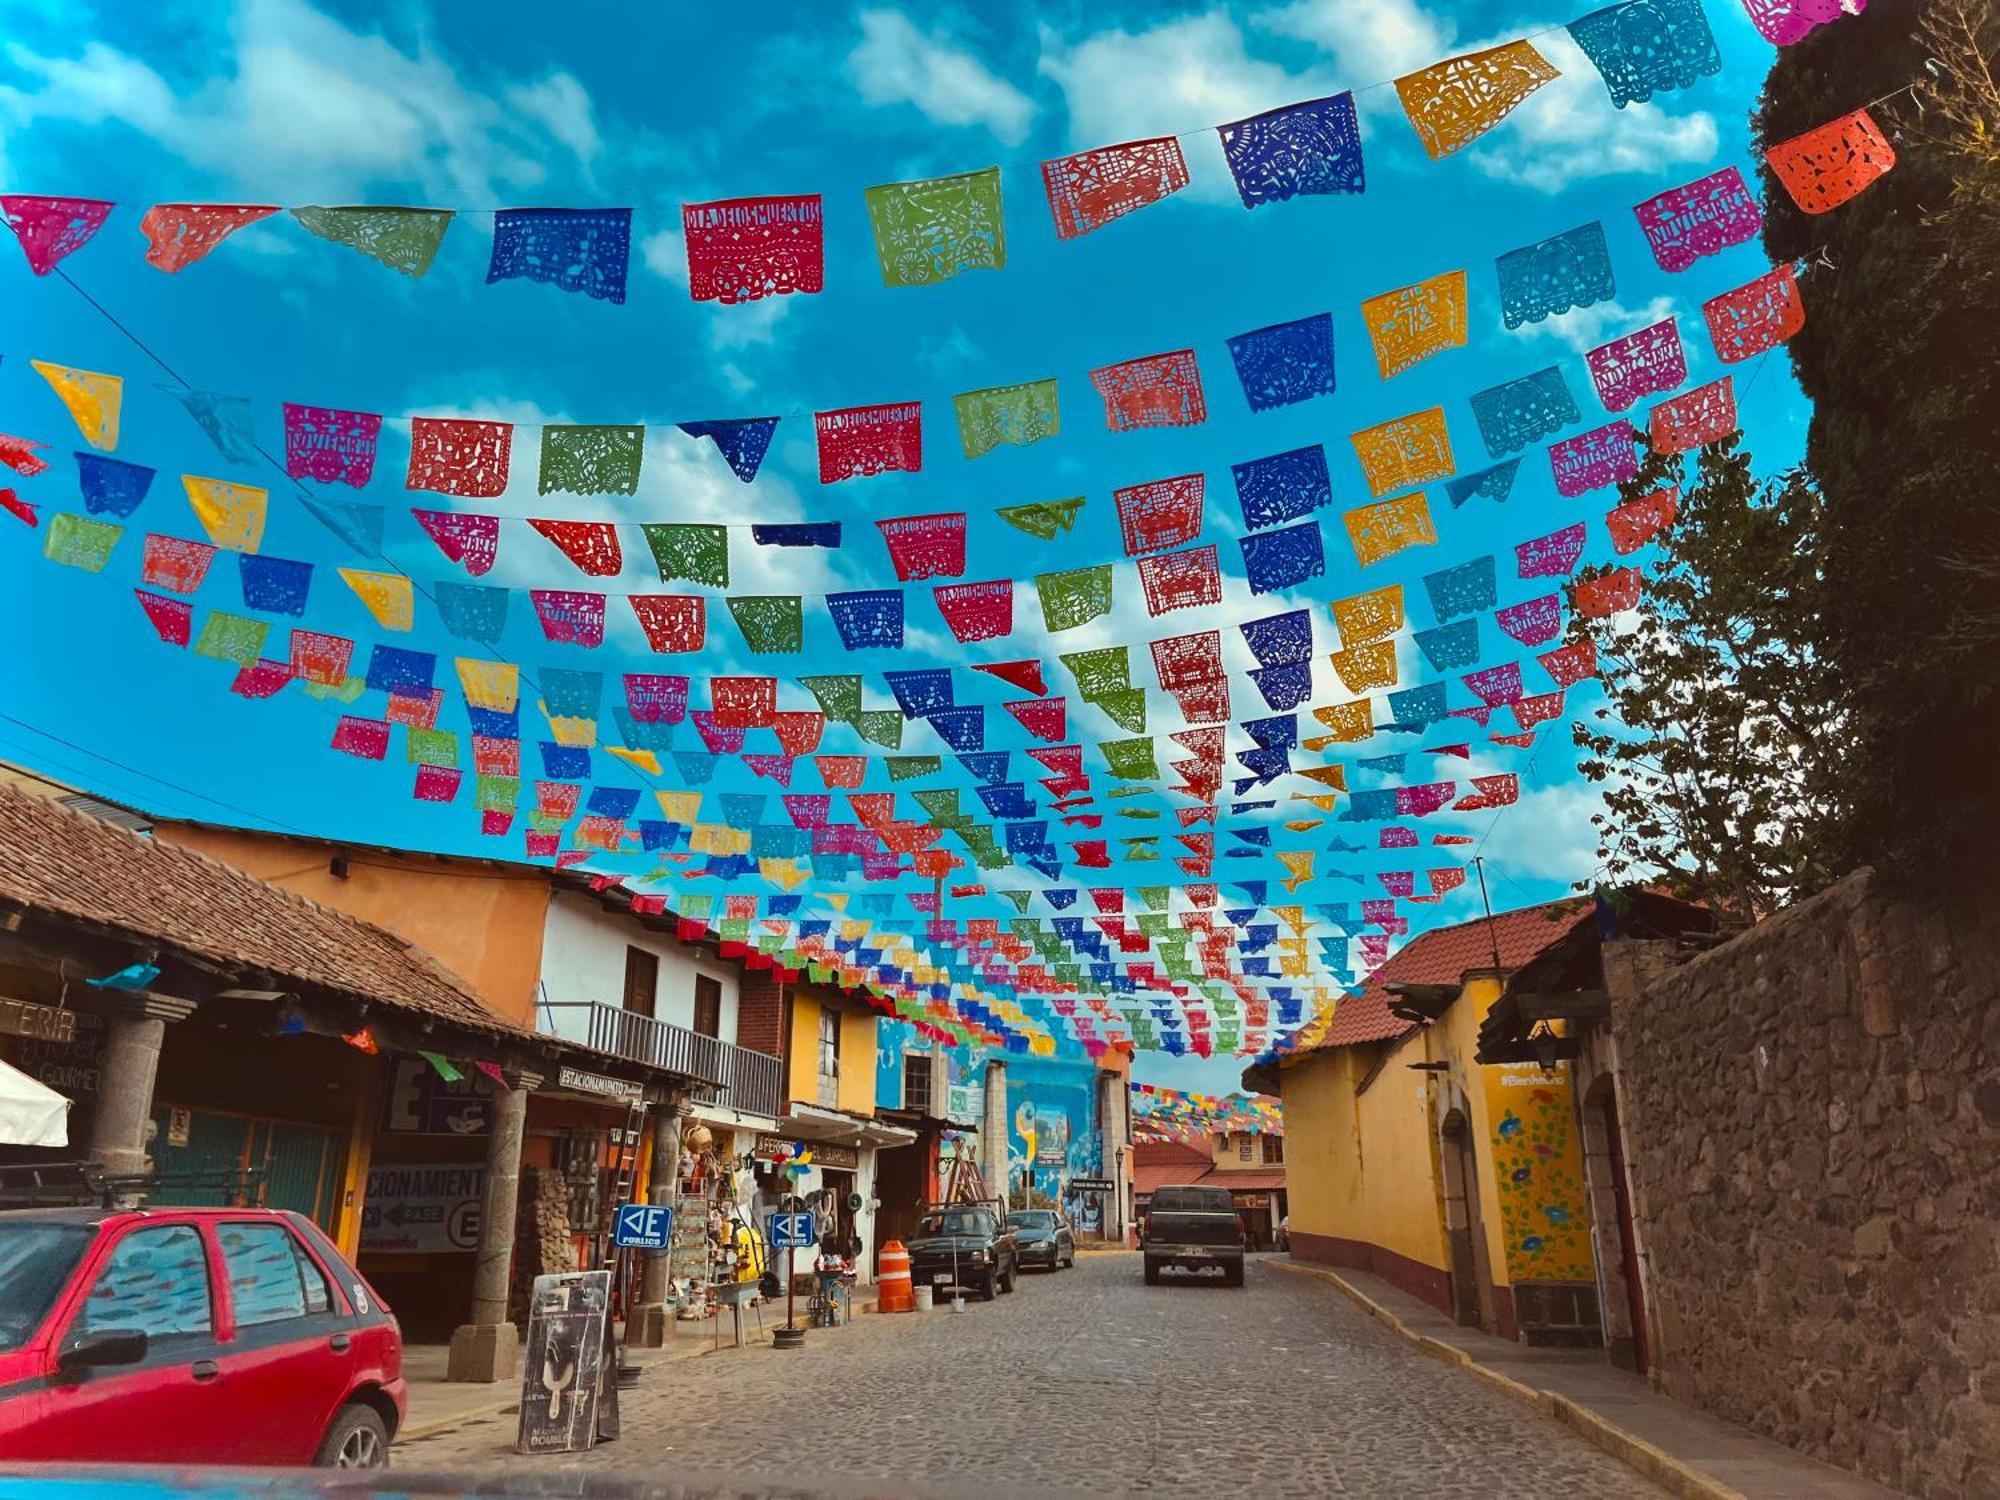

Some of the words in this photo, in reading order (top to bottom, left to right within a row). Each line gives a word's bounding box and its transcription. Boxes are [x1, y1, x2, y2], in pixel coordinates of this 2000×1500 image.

[1646, 190, 1752, 247] NOVIEMBRE
[1596, 343, 1682, 389] NOVIEMBRE
[287, 431, 376, 456] NOVIEMBRE
[562, 1069, 624, 1095] ESTACIONAMIENTO
[645, 1209, 665, 1237] E
[794, 1215, 808, 1238] E
